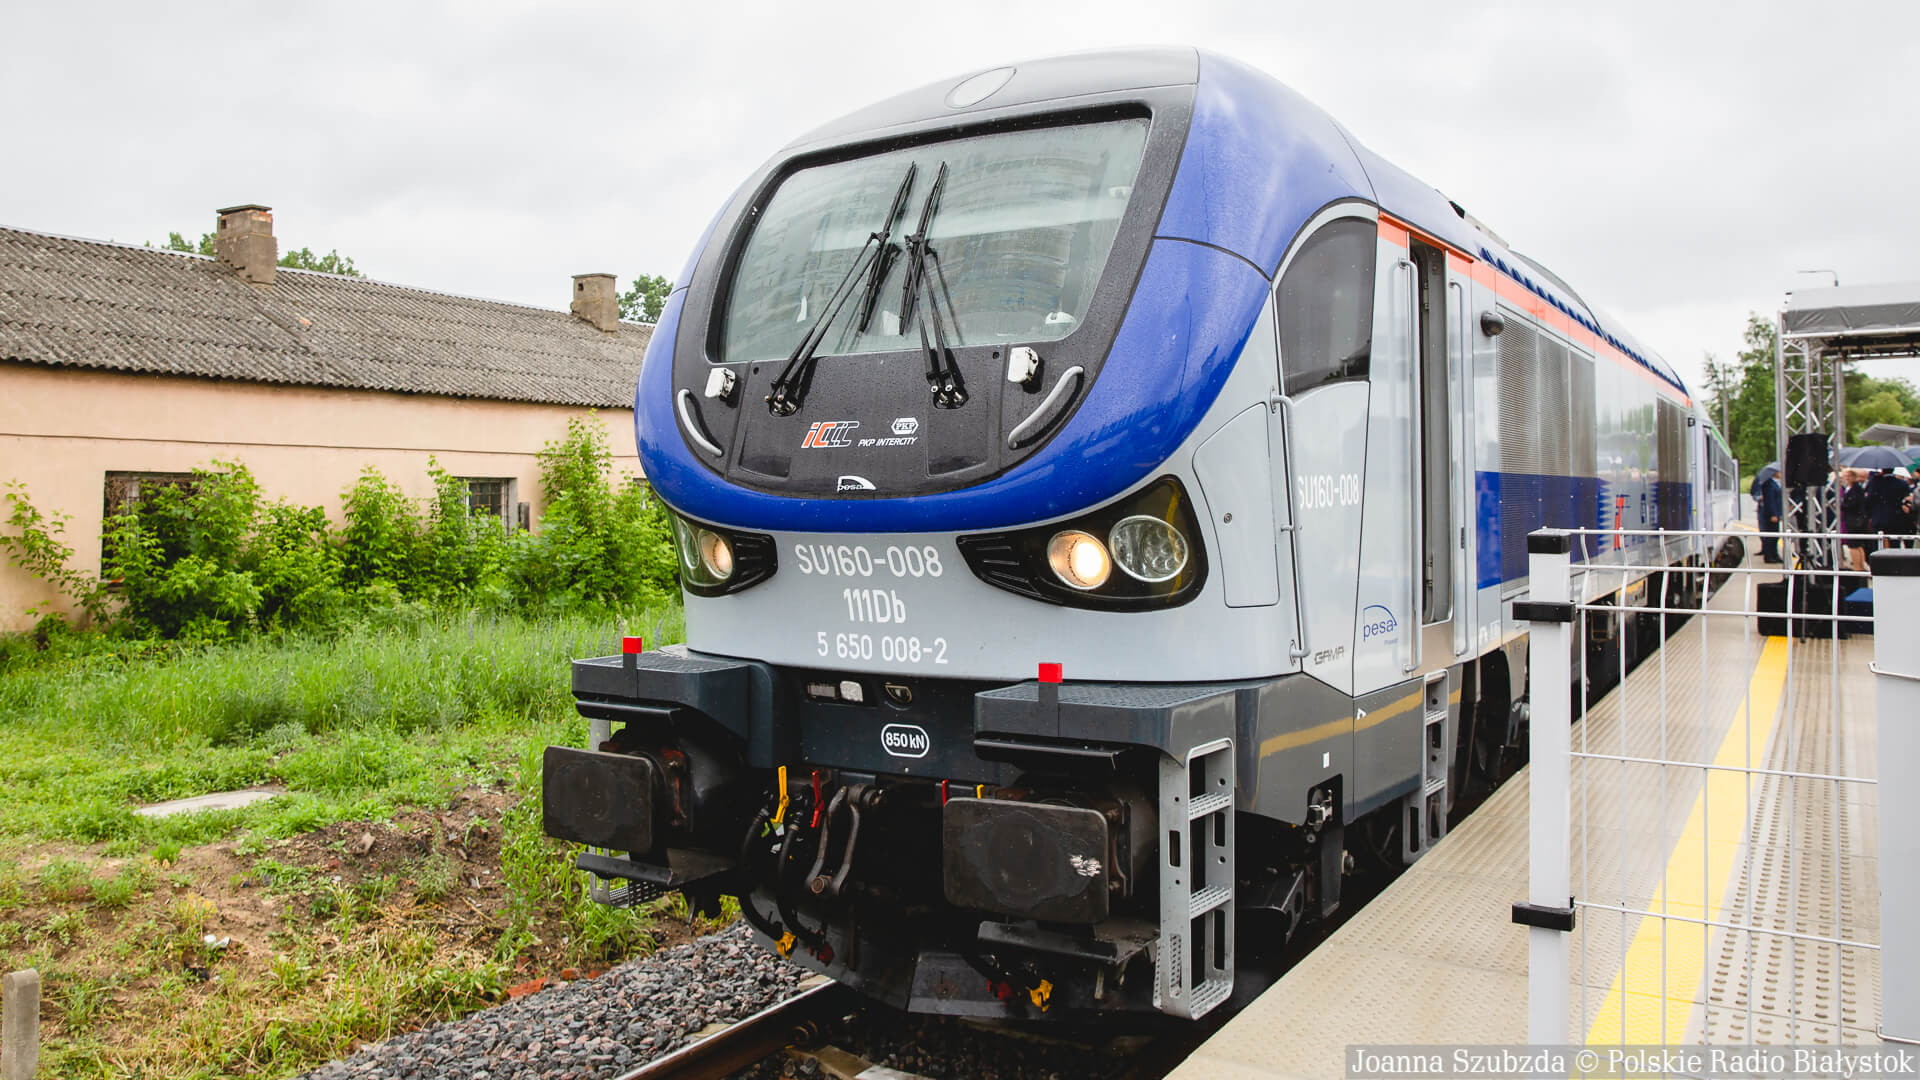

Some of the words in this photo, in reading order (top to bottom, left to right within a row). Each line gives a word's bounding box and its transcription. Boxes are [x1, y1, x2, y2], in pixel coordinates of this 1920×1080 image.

[858, 438, 875, 447] PKP
[876, 437, 918, 446] INTERCITY
[1297, 473, 1359, 510] SU160-008
[795, 544, 943, 577] SU160-008
[843, 588, 906, 623] 111Db
[1363, 619, 1394, 642] pesa
[817, 631, 828, 657] 5
[836, 633, 872, 660] 650
[881, 636, 948, 664] 008-2
[1314, 645, 1344, 665] GAMA
[886, 731, 908, 748] 850
[910, 733, 925, 749] kN
